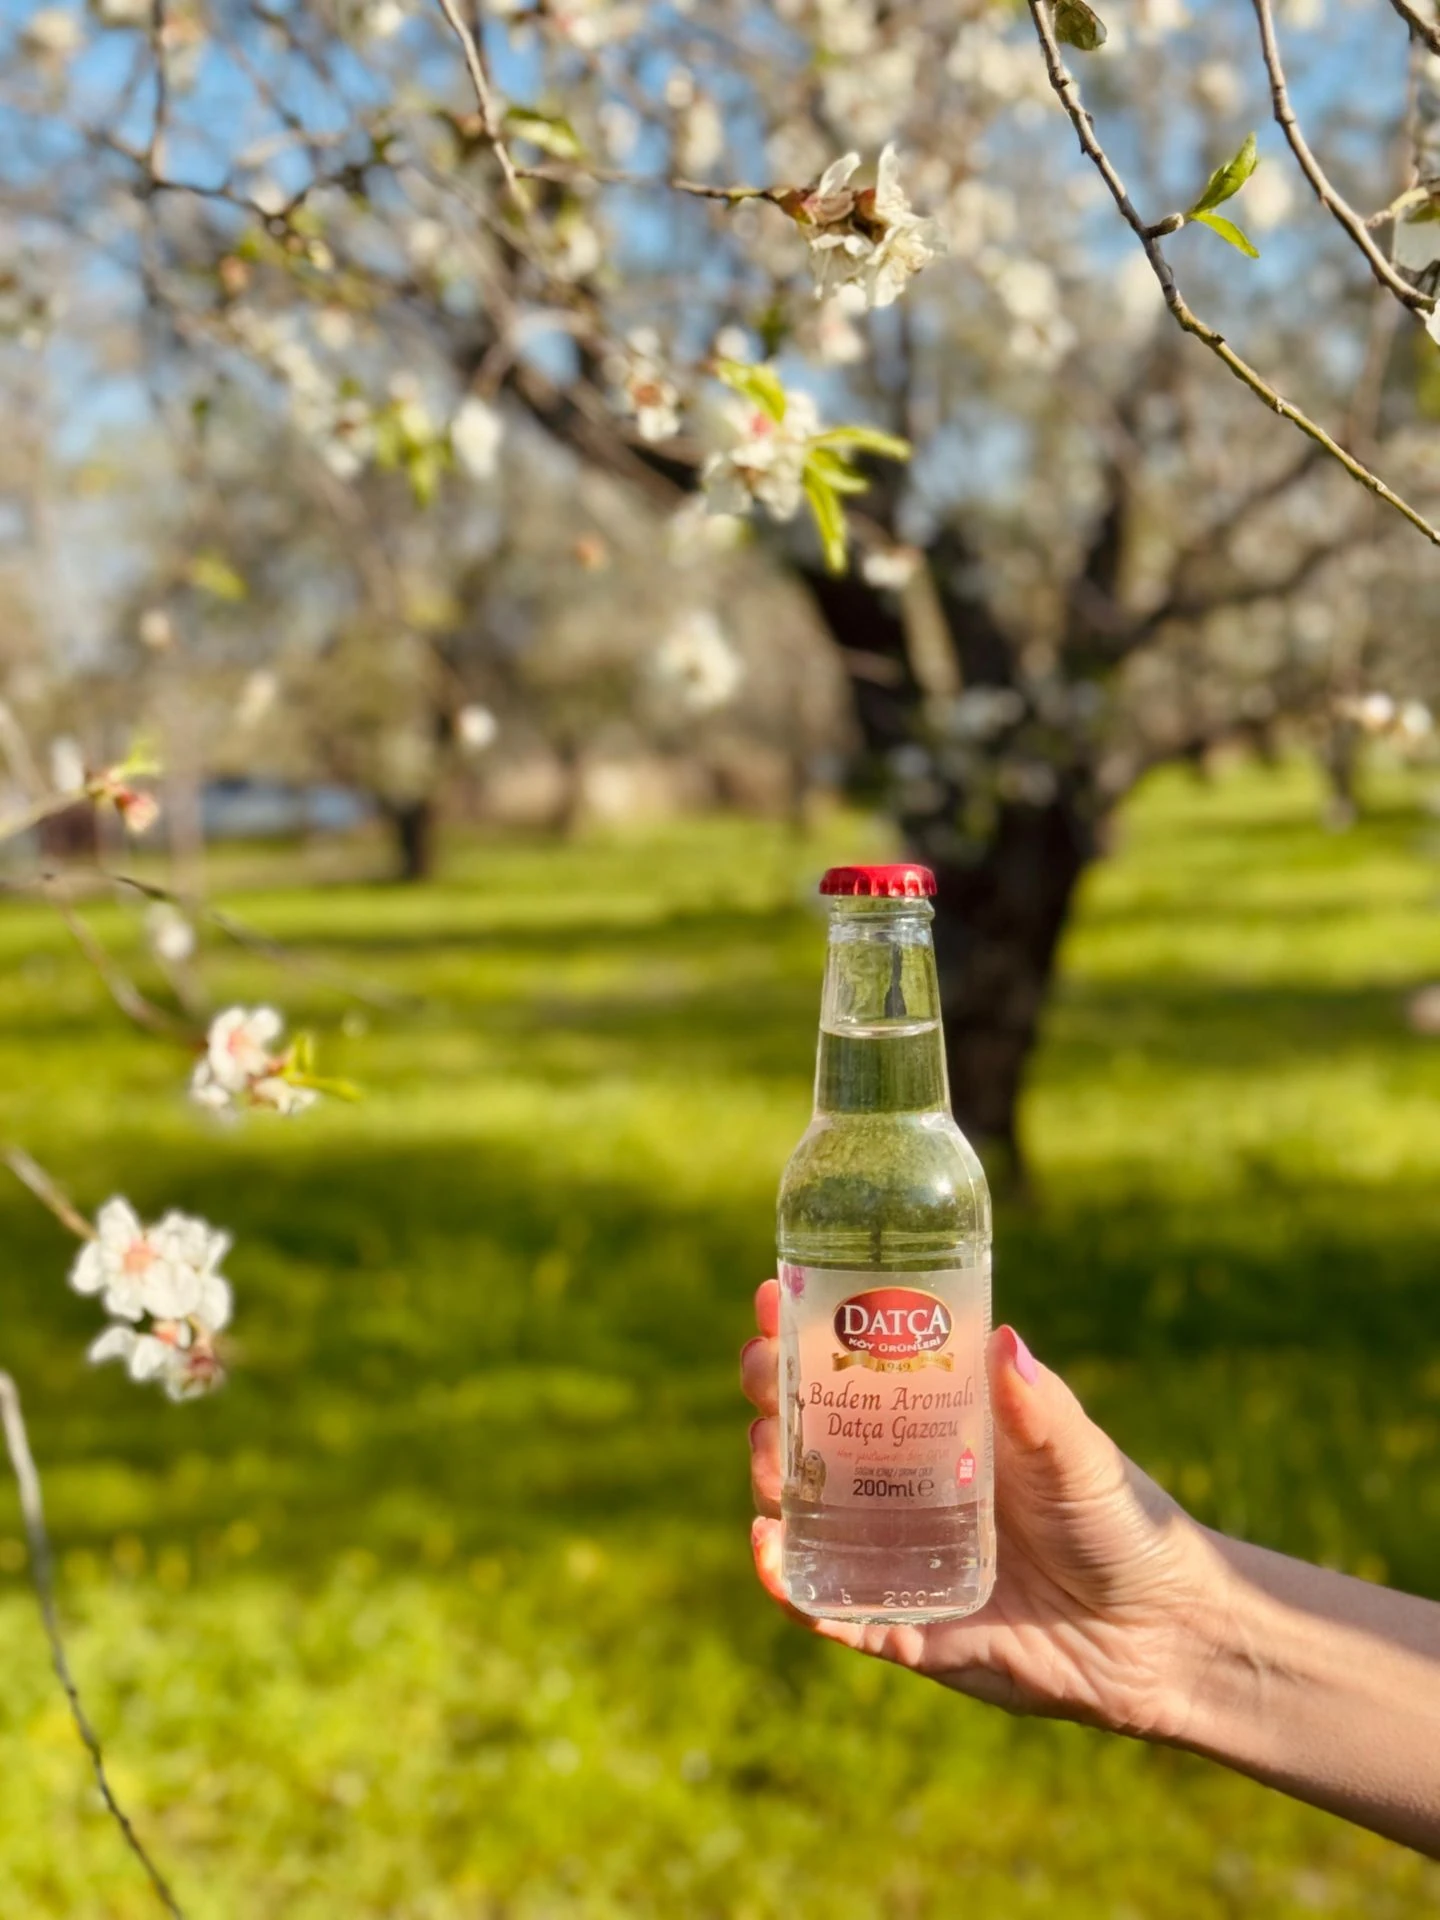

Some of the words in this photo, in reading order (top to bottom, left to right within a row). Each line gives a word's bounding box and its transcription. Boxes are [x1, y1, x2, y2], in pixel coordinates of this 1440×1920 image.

[843, 1304, 949, 1344] DATÇA
[848, 1337, 875, 1351] KÖY
[879, 1362, 912, 1373] 1949
[809, 1380, 882, 1411] Badem
[890, 1376, 974, 1411] Aromalı
[827, 1412, 884, 1446] Datça
[891, 1415, 959, 1447] Gazozu
[852, 1478, 915, 1498] 200ml
